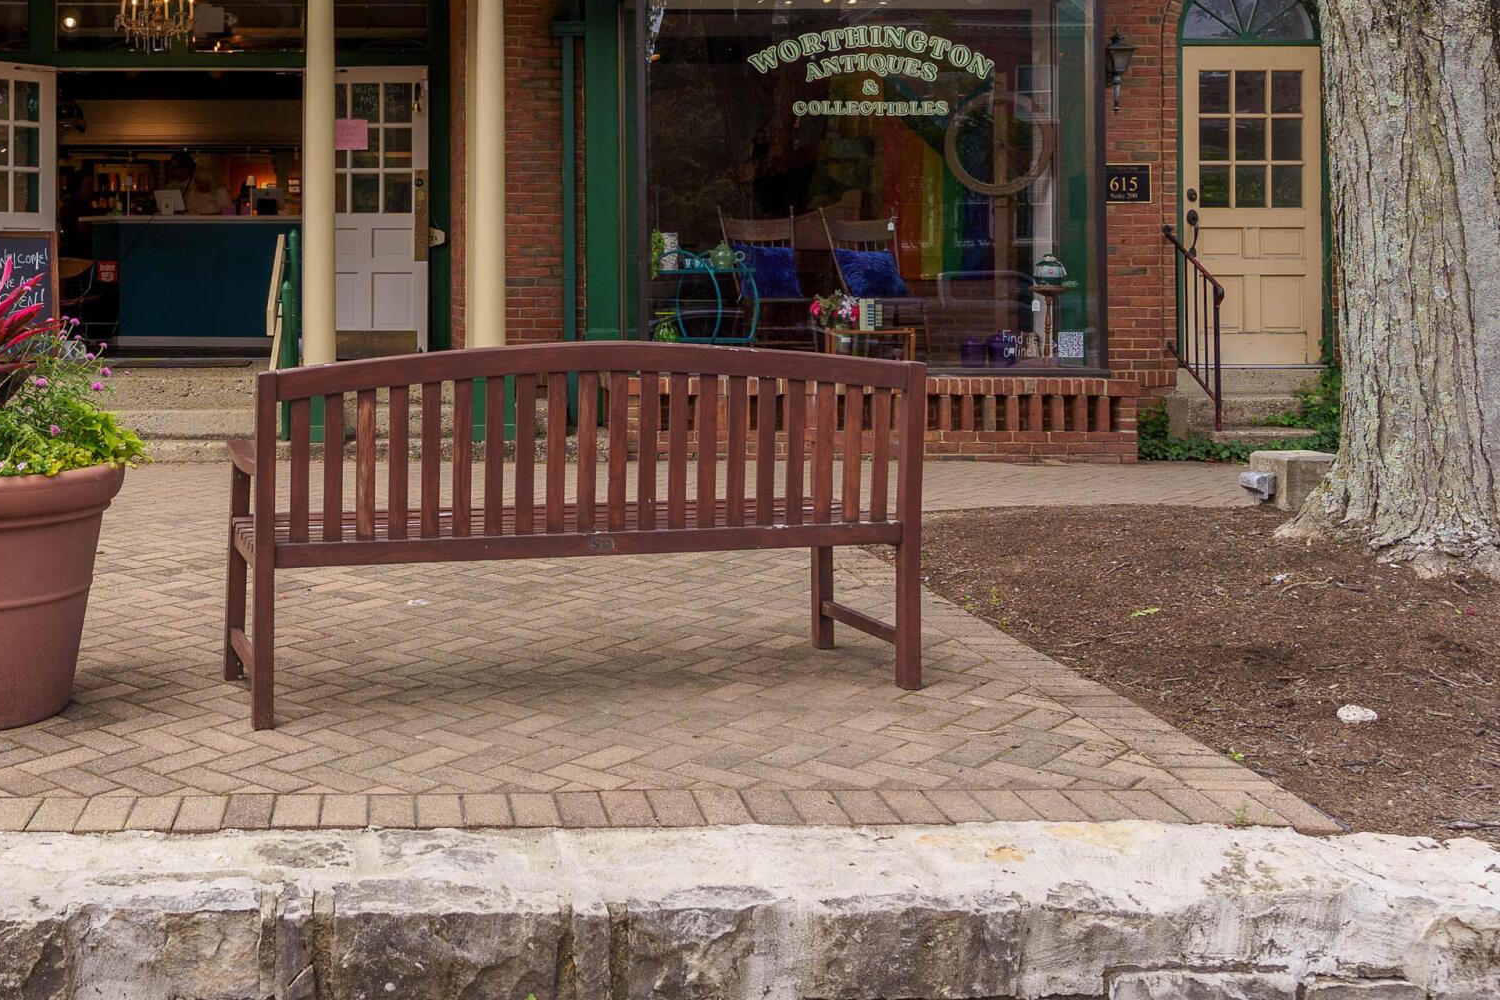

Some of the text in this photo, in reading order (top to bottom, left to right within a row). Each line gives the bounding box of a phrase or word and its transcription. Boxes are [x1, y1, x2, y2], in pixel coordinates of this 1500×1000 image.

[747, 25, 995, 79] WORTHINGTON
[805, 53, 938, 82] ANTIQUES
[862, 79, 879, 95] &
[792, 100, 949, 116] COLLECTIBLES
[1109, 176, 1138, 191] 615
[1002, 330, 1023, 344] Find
